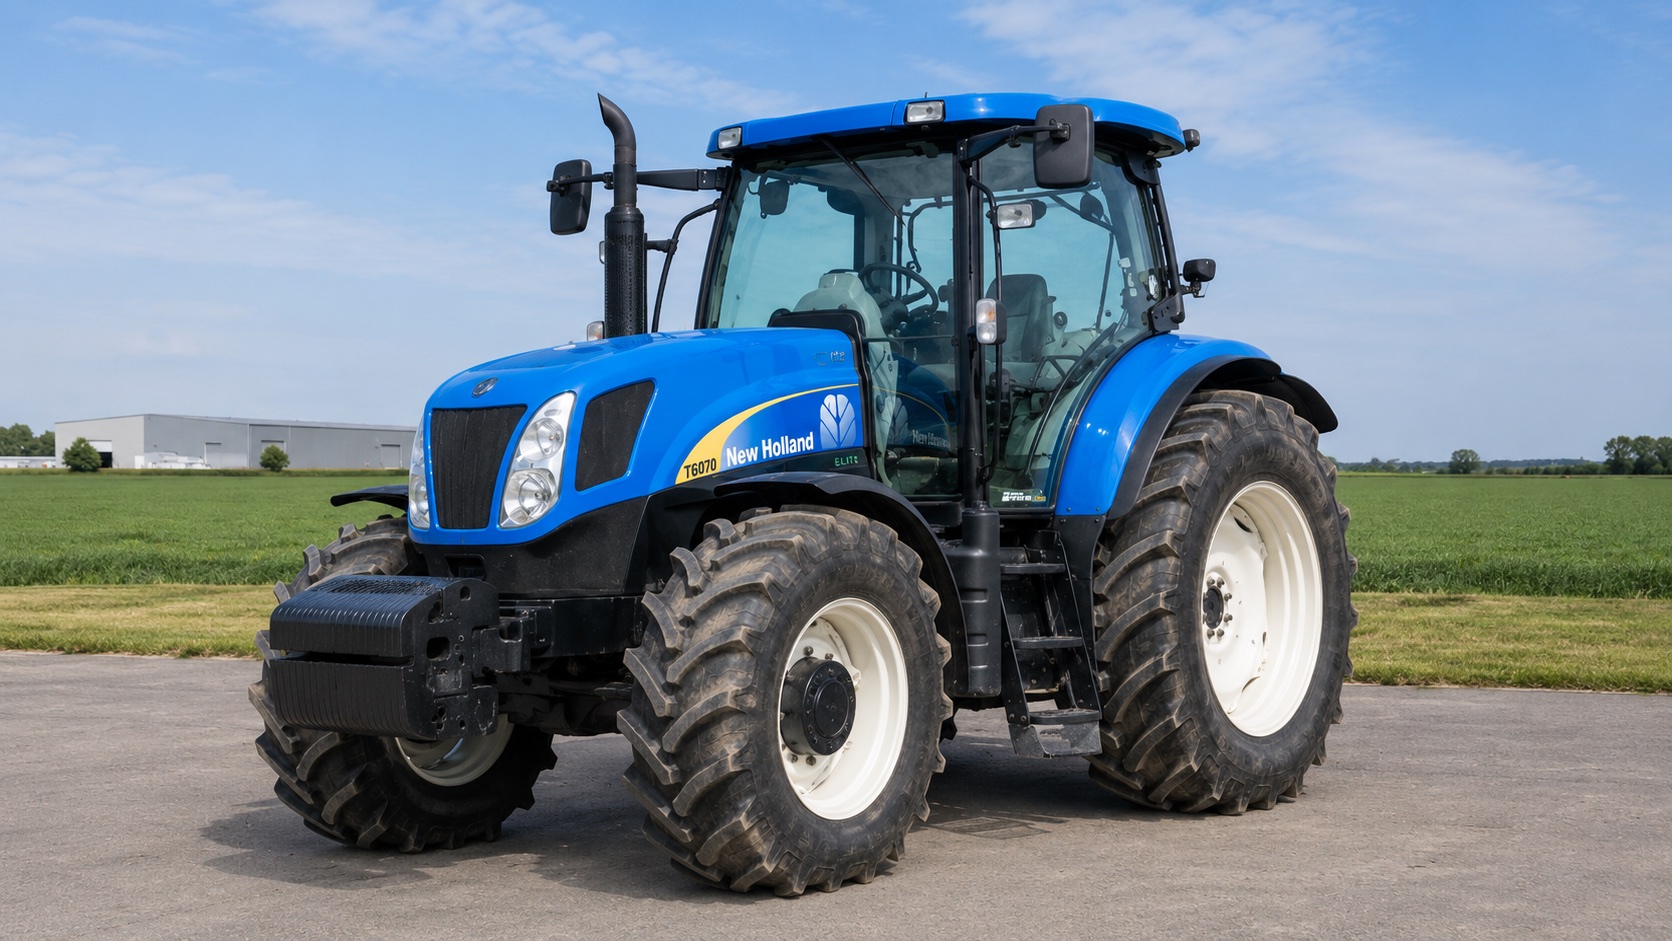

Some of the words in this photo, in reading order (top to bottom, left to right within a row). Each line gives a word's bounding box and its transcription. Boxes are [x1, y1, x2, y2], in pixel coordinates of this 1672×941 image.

[726, 446, 758, 467] New
[761, 431, 814, 459] Holland
[684, 457, 717, 479] T6070
